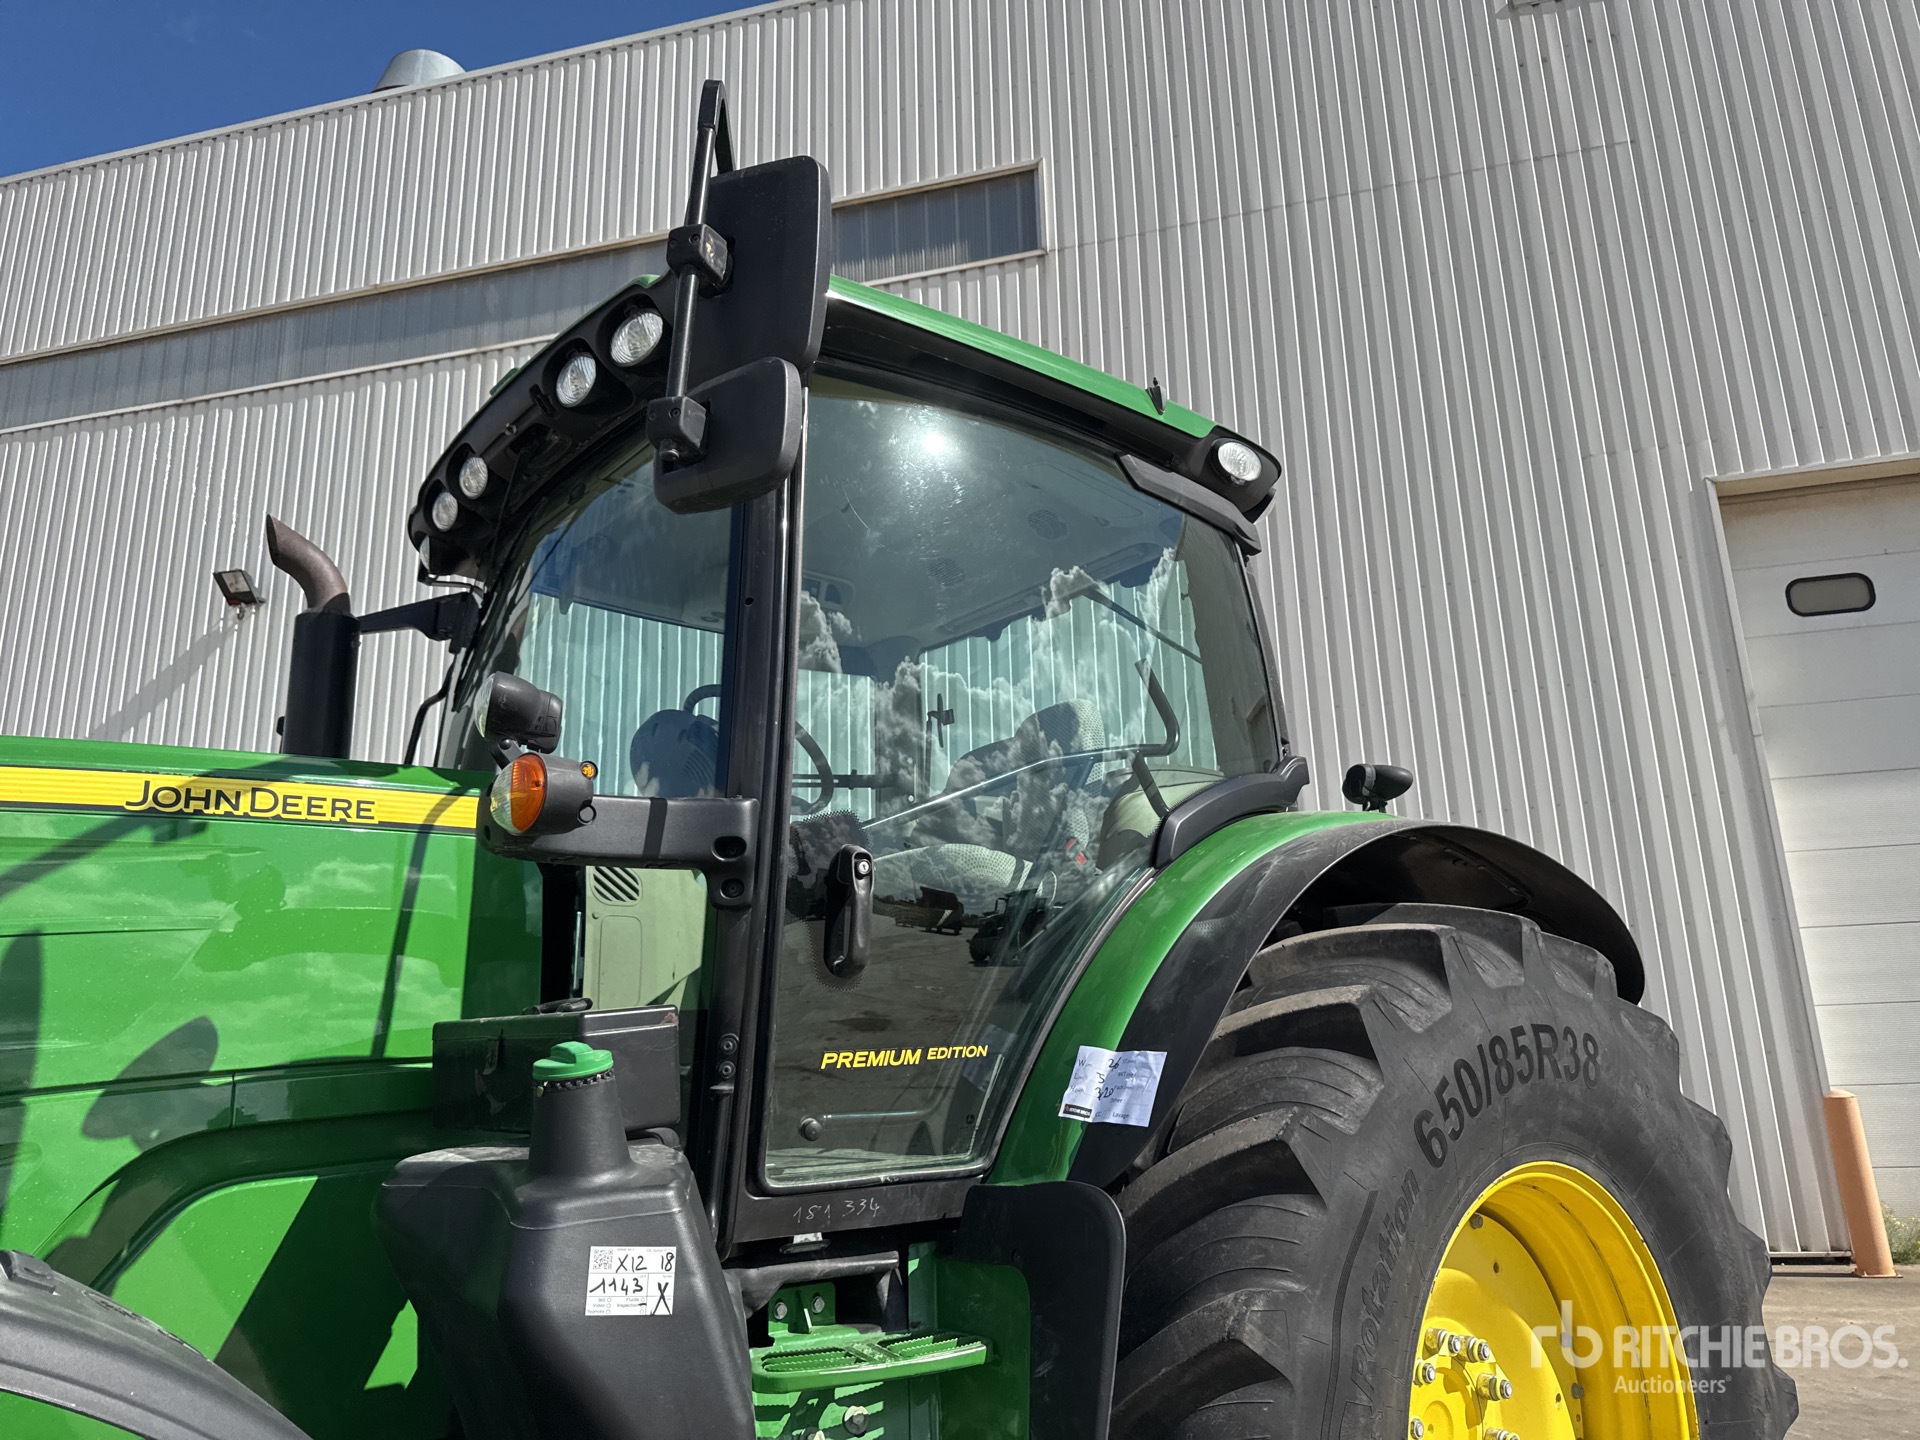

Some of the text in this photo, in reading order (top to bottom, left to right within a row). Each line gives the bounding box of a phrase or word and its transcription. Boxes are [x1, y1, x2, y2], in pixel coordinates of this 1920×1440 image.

[125, 780, 376, 820] JOHN DEERE
[820, 1045, 988, 1070] PREMIUM EDITION
[1413, 1023, 1600, 1169] 650/85R38
[842, 1197, 880, 1218] 334
[661, 1251, 675, 1272] 18
[589, 1277, 643, 1296] 1143
[1350, 1168, 1420, 1403] Rotation
